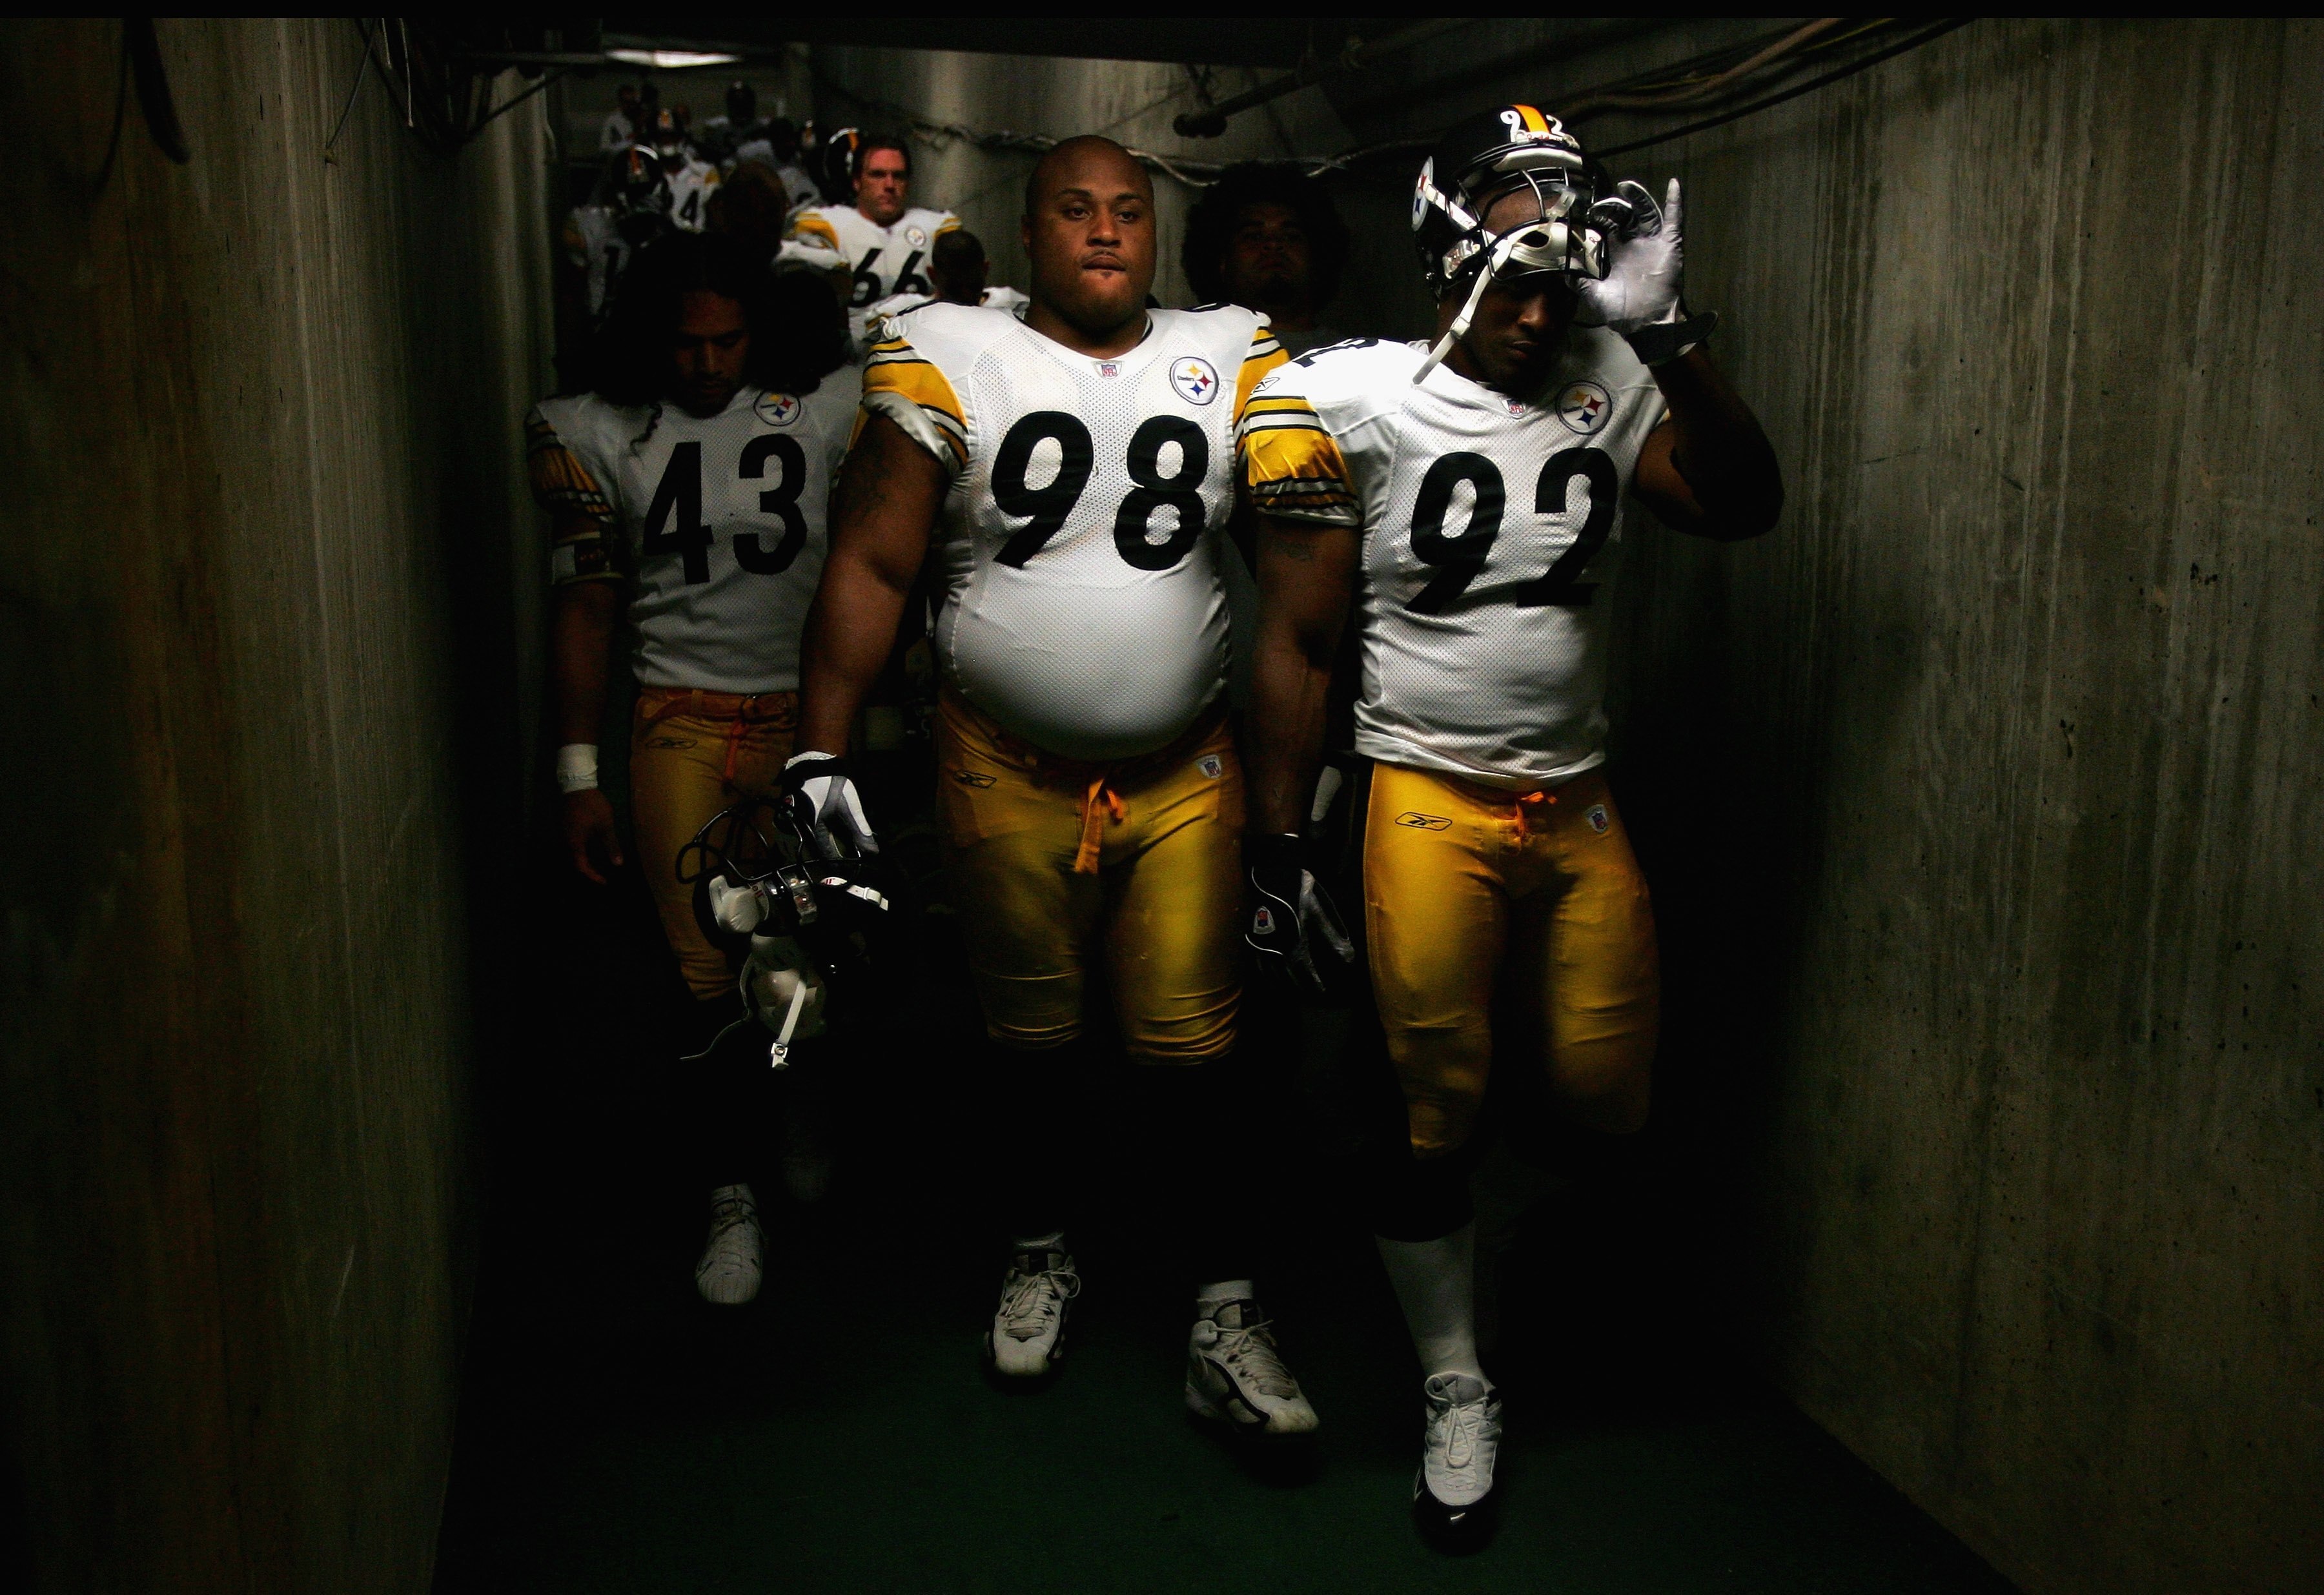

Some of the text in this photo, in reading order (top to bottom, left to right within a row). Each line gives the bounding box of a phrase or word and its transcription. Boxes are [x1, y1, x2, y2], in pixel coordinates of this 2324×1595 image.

[1500, 110, 1565, 142] 92
[850, 249, 928, 306] 66
[644, 434, 807, 584] 43
[991, 411, 1208, 570] 98
[1404, 447, 1619, 614] 92
